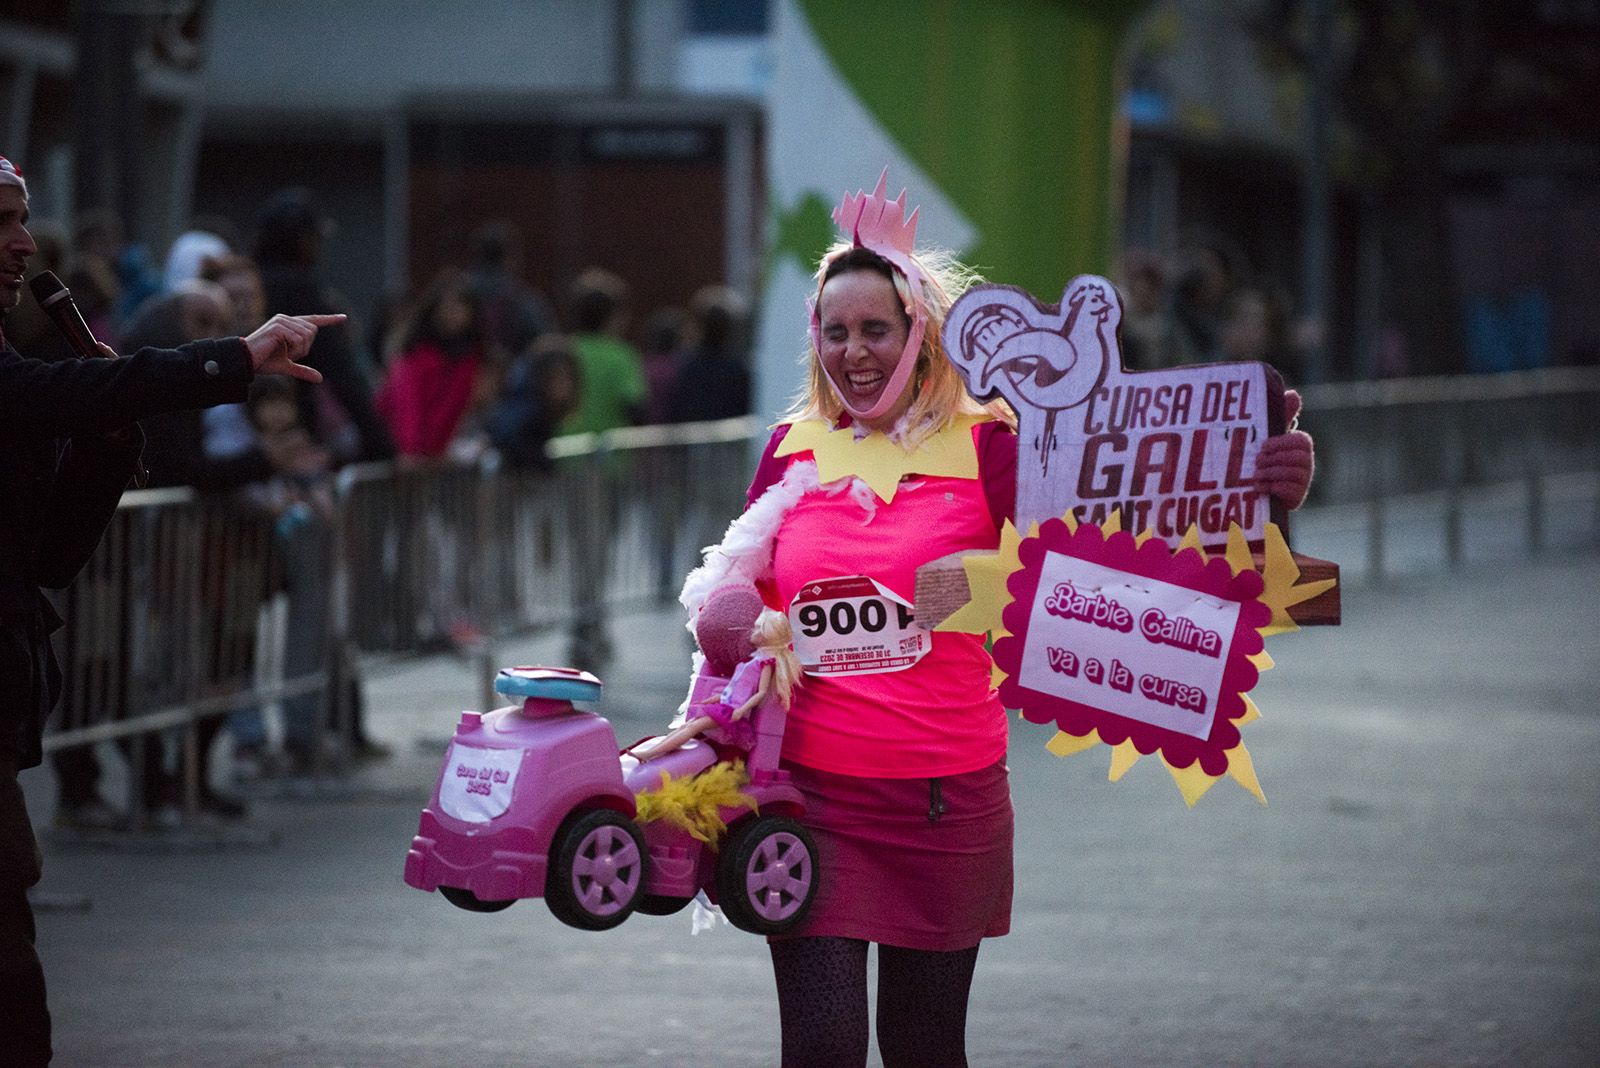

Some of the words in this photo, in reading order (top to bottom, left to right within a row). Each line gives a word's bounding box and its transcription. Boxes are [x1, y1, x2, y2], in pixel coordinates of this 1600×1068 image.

[1083, 383, 1193, 435] CURSA
[1200, 379, 1252, 424] DEL
[1076, 426, 1257, 499] GALL
[1157, 491, 1260, 538] CUGAT
[1044, 581, 1134, 633] Barbie
[1139, 607, 1223, 659] Gallina
[1046, 647, 1080, 678] va
[1084, 657, 1104, 685] a
[1108, 659, 1133, 694] la
[1139, 674, 1208, 715] cursa
